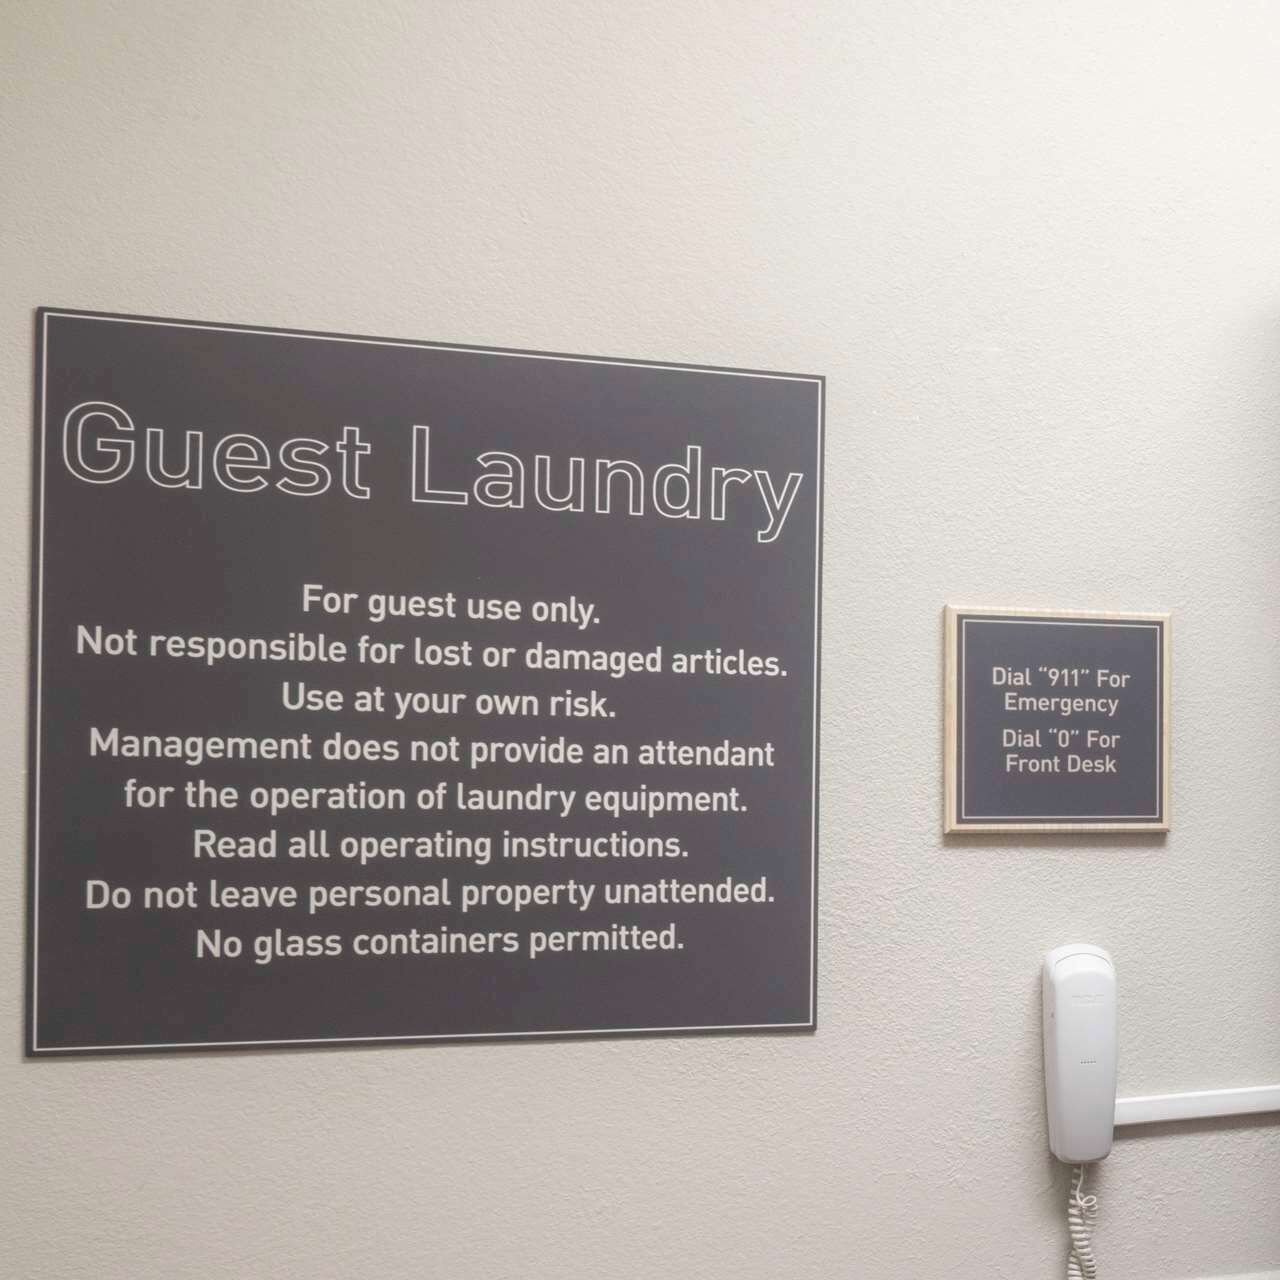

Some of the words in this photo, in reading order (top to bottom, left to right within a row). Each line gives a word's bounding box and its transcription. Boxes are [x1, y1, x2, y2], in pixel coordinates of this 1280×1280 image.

[64, 402, 371, 499] Guest
[412, 425, 803, 543] Laundry
[303, 584, 358, 613] For
[369, 593, 456, 622] guest
[468, 599, 521, 620] use
[532, 596, 599, 630] only.
[78, 625, 137, 655] Not
[151, 633, 346, 665] responsible
[358, 635, 405, 664] for
[415, 637, 472, 666] lost
[483, 647, 516, 667] or
[526, 642, 662, 678] damaged
[672, 648, 787, 676] articles.
[992, 667, 1032, 686] Dial
[1097, 669, 1130, 688] For
[283, 682, 343, 711] Use
[355, 687, 384, 712] at
[395, 692, 466, 719] your
[476, 695, 538, 716] own
[550, 690, 615, 717] risk.
[1004, 692, 1119, 716] Emergency
[91, 728, 312, 765] Management
[323, 732, 399, 760] does
[411, 737, 460, 761] not
[471, 736, 583, 769] provide
[593, 744, 628, 764] an
[639, 740, 775, 766] attendant
[1003, 729, 1041, 748] Dial
[1087, 730, 1120, 748] For
[1006, 755, 1060, 773] Front
[1068, 755, 1116, 773] Desk
[124, 779, 174, 807] for
[185, 780, 238, 808] the
[251, 781, 405, 815] operation
[417, 782, 447, 809] of
[458, 782, 576, 817] laundry
[585, 784, 747, 818] equipment.
[195, 830, 276, 857] Read
[289, 830, 330, 857] all
[341, 830, 491, 865] operating
[504, 830, 688, 857] instructions.
[87, 880, 130, 908] Do
[145, 882, 197, 908] not
[211, 880, 297, 907] leave
[310, 878, 451, 914] personal
[462, 880, 595, 912] property
[605, 876, 774, 904] unattended.
[198, 930, 242, 957] No
[255, 929, 342, 964] glass
[354, 926, 519, 955] containers
[530, 923, 683, 959] permitted.
